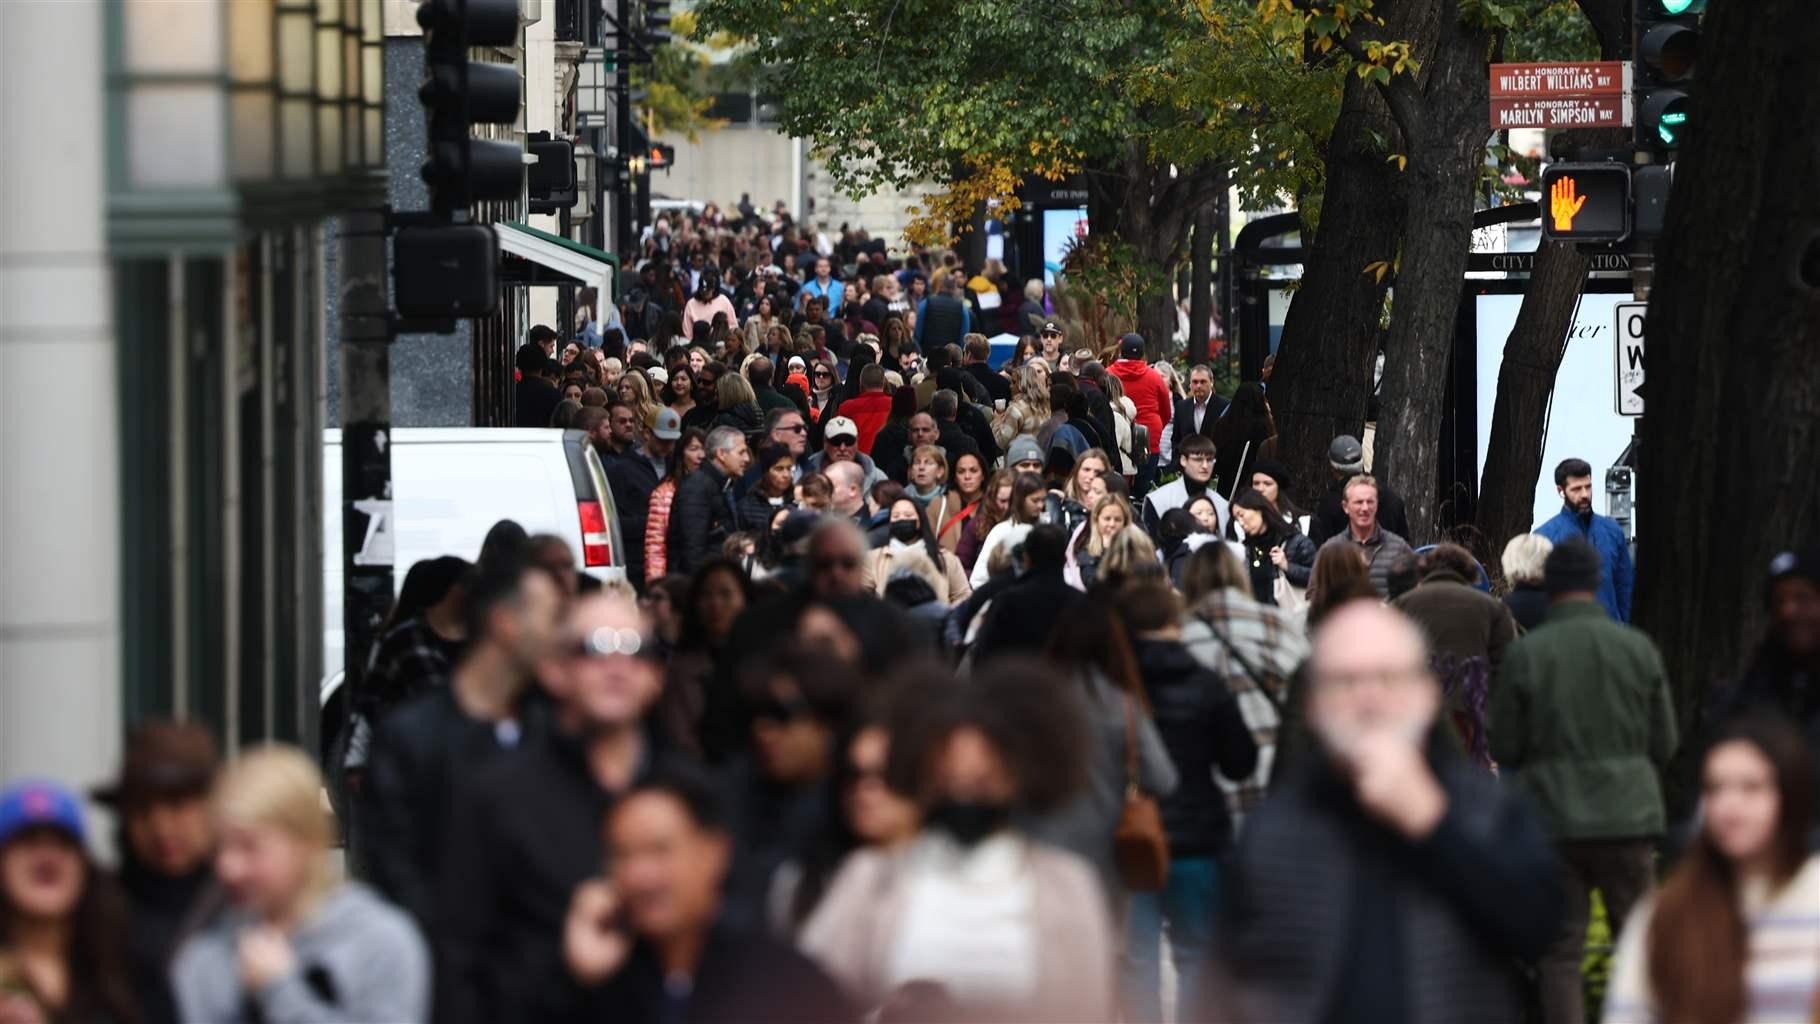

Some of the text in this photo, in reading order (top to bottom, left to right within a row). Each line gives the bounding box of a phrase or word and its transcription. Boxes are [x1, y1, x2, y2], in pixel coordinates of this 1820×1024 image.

[1535, 67, 1580, 75] HONORARY
[1500, 74, 1611, 91] WILBERT WILLIAMS WAY
[1535, 100, 1580, 108] HONORARY
[1500, 107, 1613, 125] MARILYN SIMPSON WAY
[1492, 255, 1526, 269] CITY
[1591, 254, 1630, 268] TION
